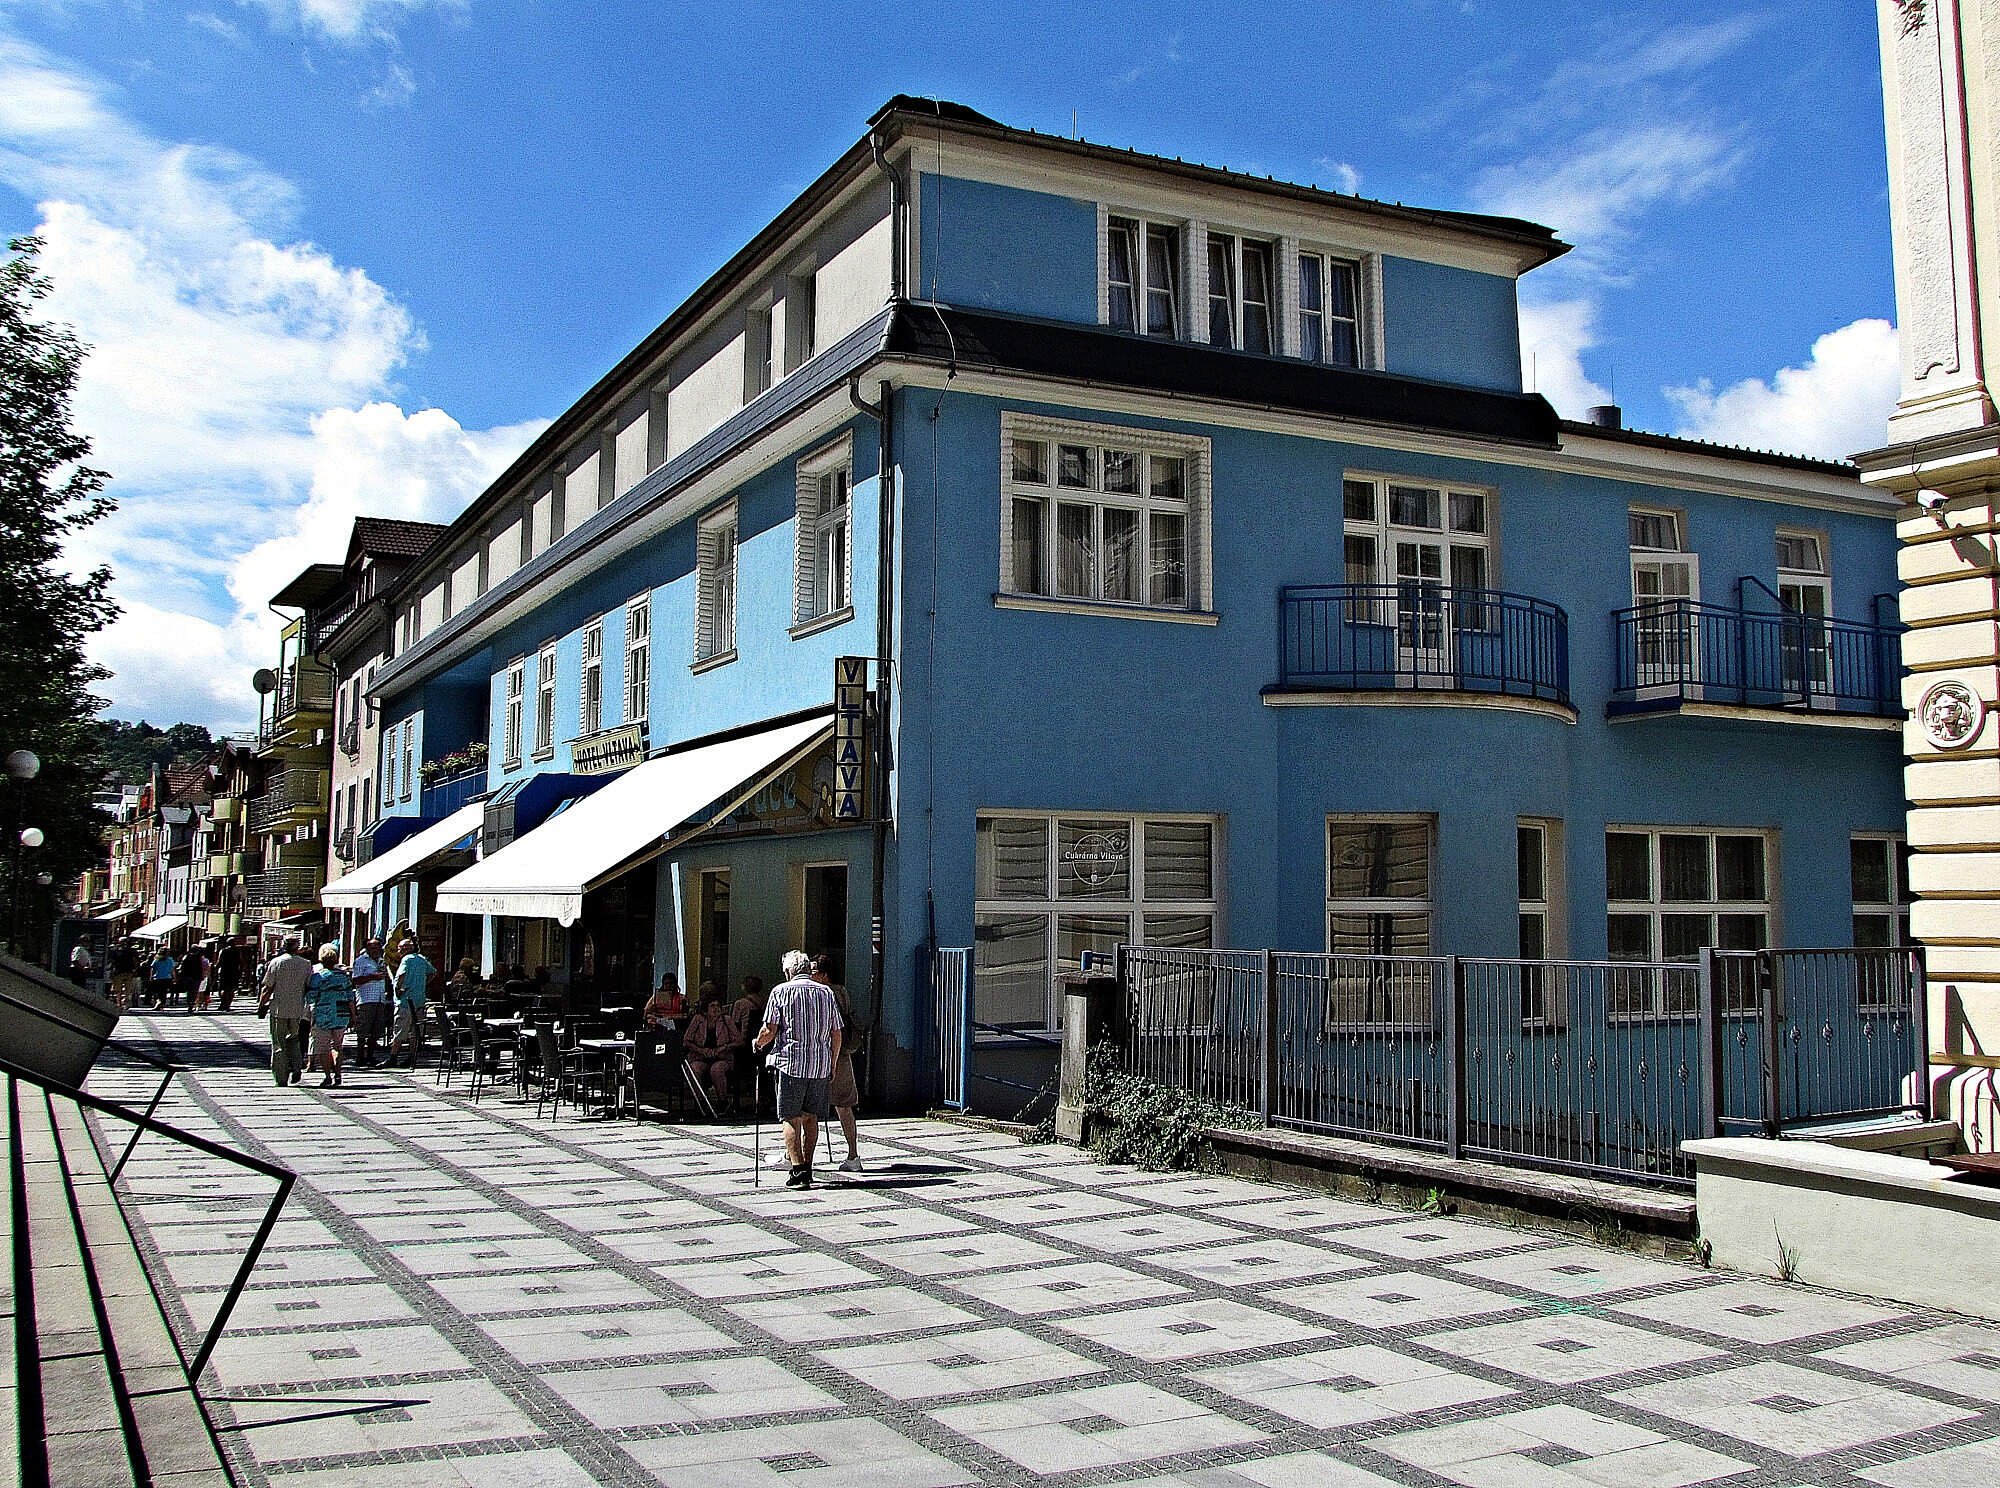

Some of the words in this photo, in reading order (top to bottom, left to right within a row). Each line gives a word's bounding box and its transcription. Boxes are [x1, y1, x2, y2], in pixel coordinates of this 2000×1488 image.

[576, 746, 603, 773] HOTEL
[602, 736, 636, 766] VLTAVA
[840, 661, 860, 817] VLTAVA
